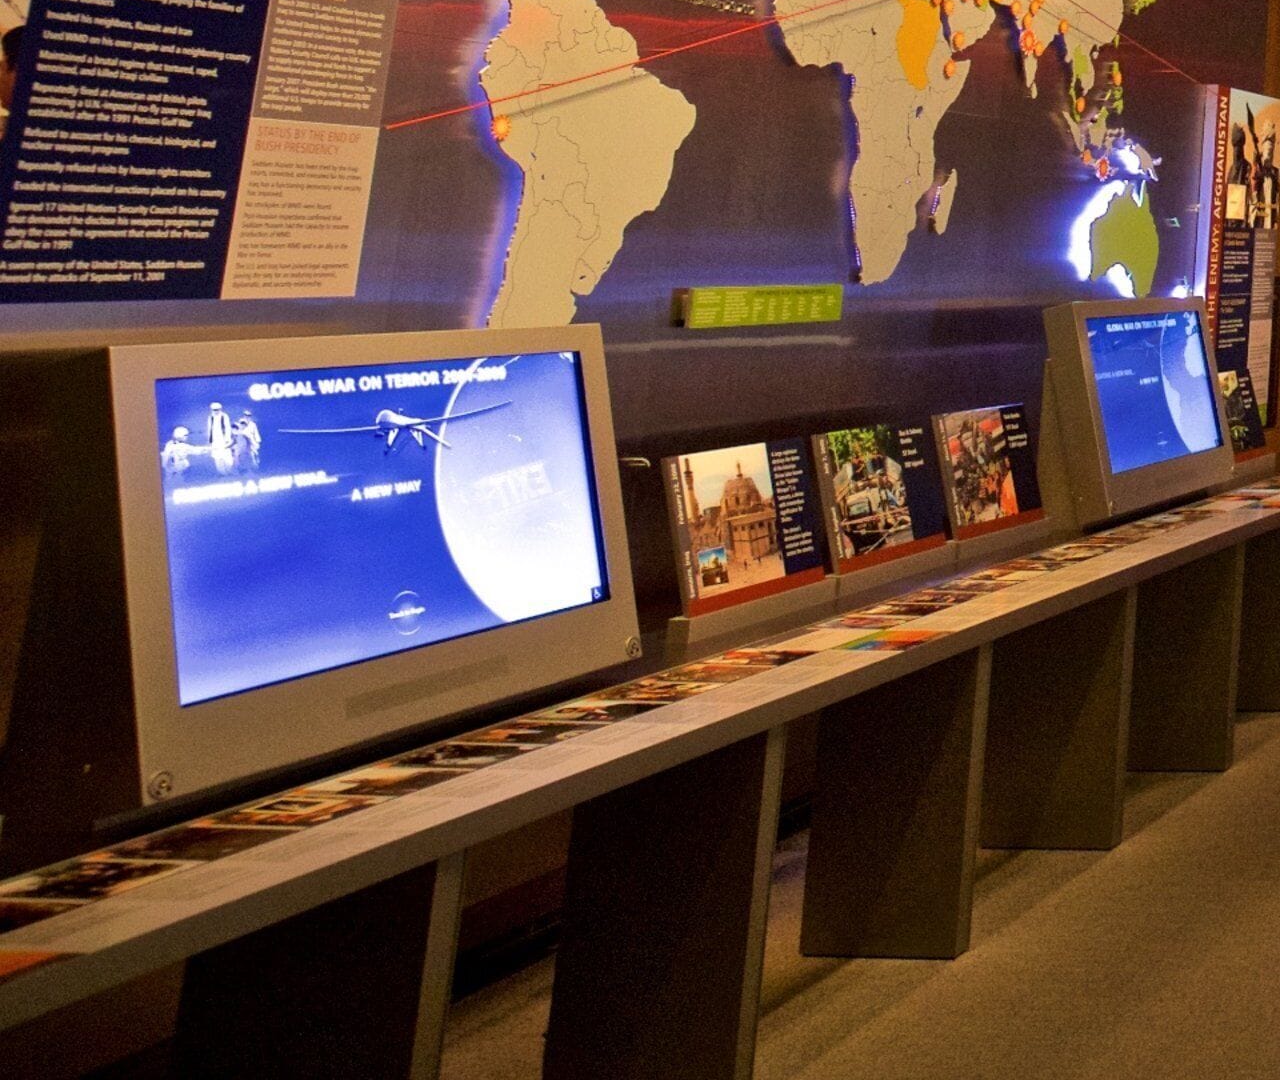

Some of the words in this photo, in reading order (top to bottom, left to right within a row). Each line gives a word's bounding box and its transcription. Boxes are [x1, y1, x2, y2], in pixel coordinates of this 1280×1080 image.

[255, 139, 284, 152] BUSH
[285, 142, 340, 155] PRESIDENCY
[257, 126, 292, 139] STATUS
[293, 128, 308, 140] BY
[309, 129, 326, 141] THE
[327, 131, 348, 143] END
[348, 132, 361, 144] OF
[1213, 95, 1230, 220] AFGHANISTAN
[1209, 222, 1221, 285] ENEMY:
[1206, 290, 1217, 322] THE
[248, 381, 316, 401] GLOBAL
[317, 378, 356, 394] WAR
[359, 376, 383, 391] ON
[385, 371, 440, 389] TERROR
[351, 488, 362, 501] A
